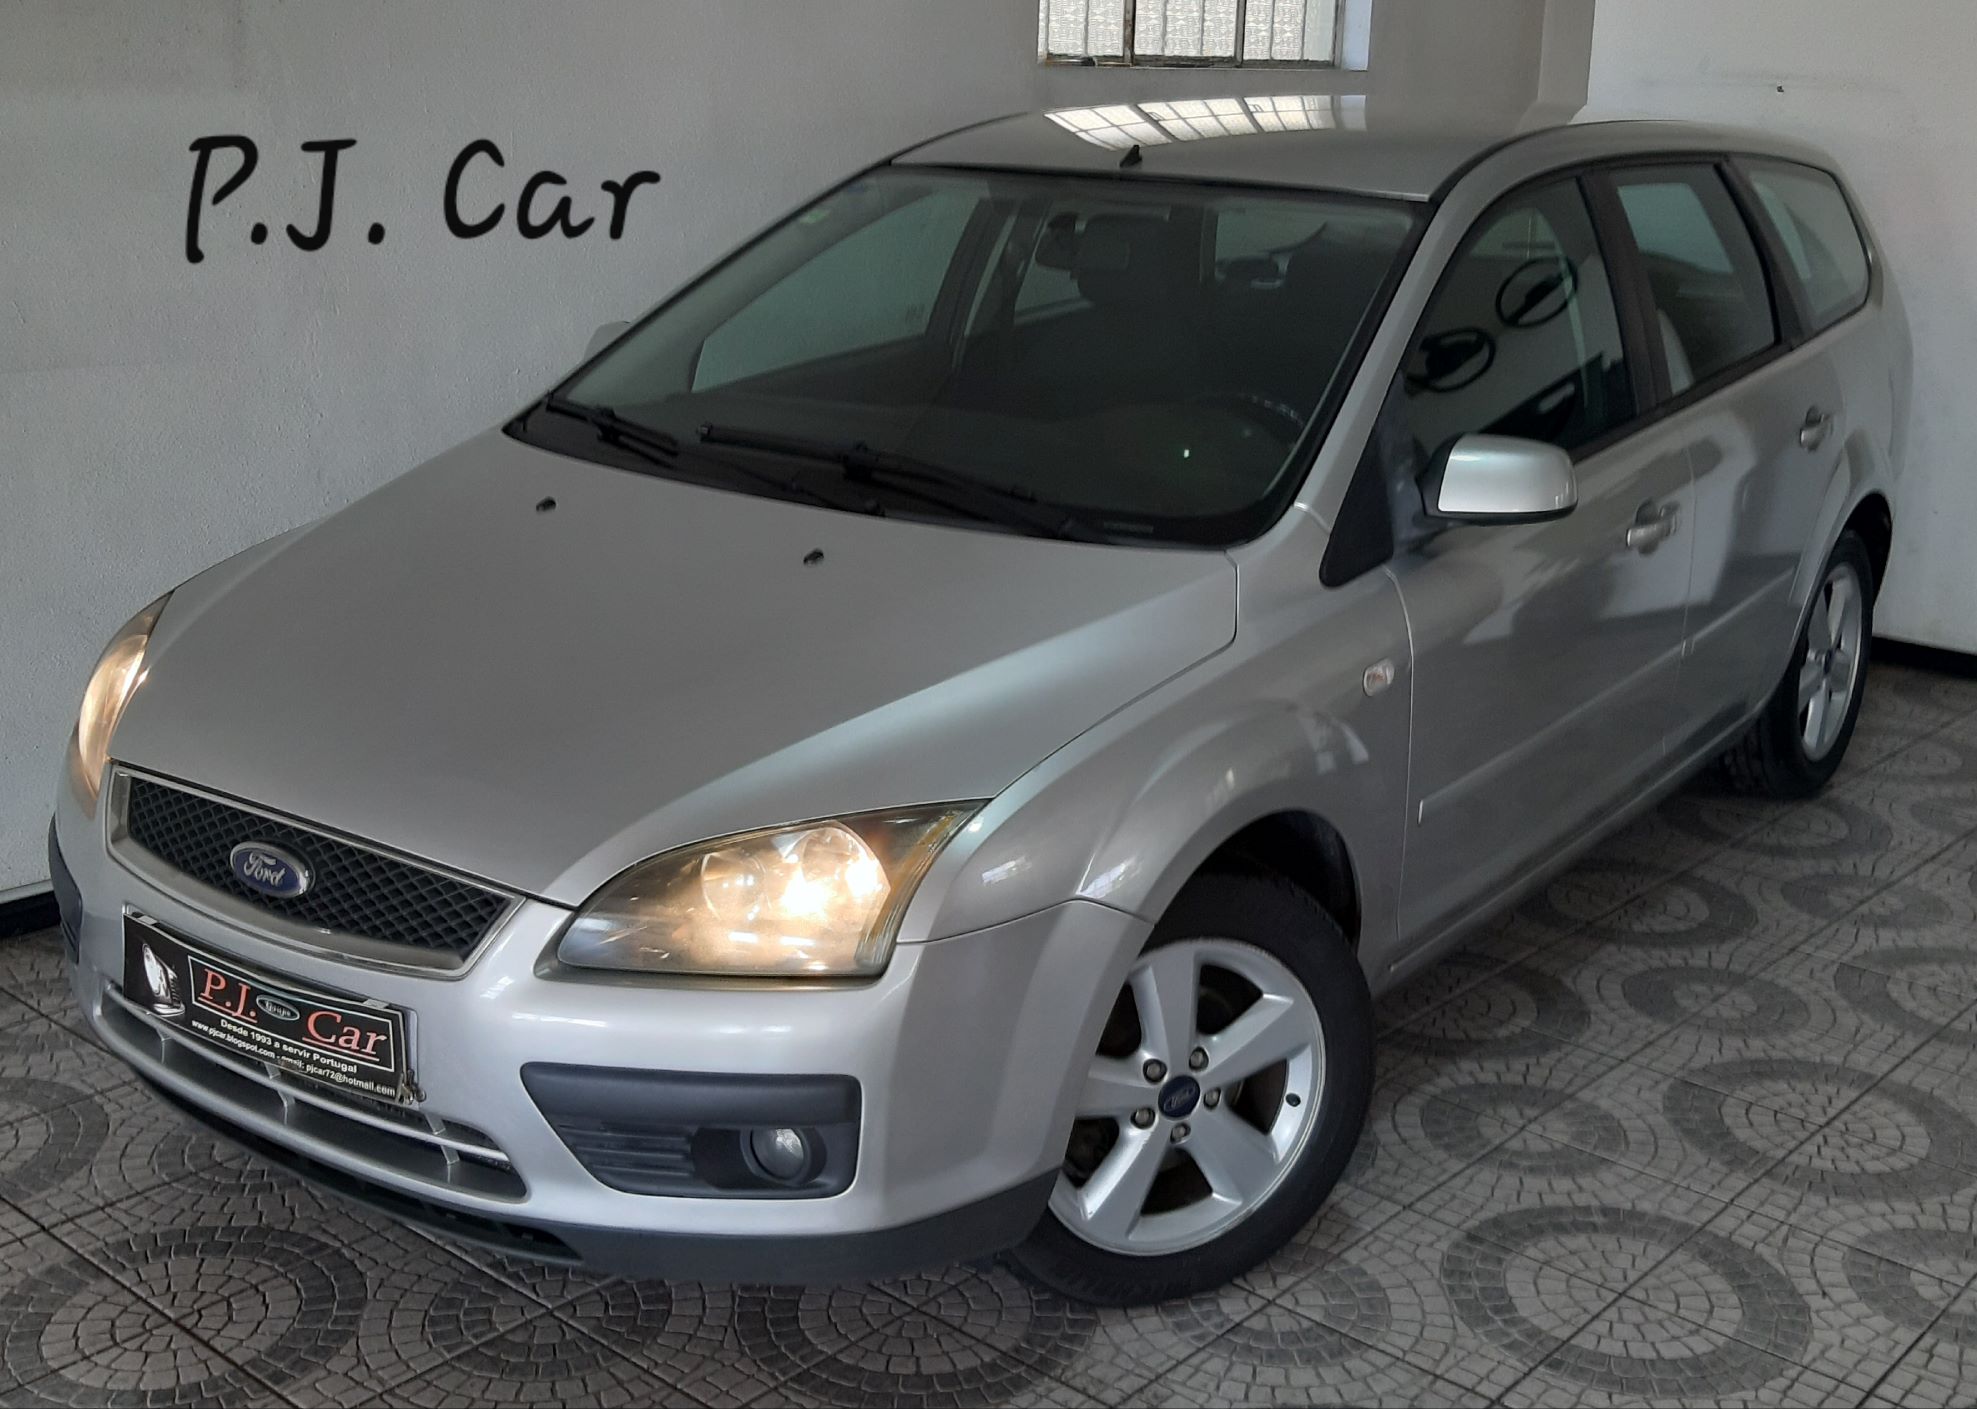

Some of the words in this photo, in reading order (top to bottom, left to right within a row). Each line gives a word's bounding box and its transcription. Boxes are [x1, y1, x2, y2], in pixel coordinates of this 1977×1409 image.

[186, 135, 385, 264] P.J.
[444, 138, 661, 241] Car
[244, 851, 286, 887] Ford
[200, 968, 258, 1018] P.J.
[307, 1011, 387, 1055] Car
[220, 1019, 249, 1037] Desde
[250, 1031, 272, 1046] 1993
[273, 1041, 280, 1049] a
[282, 1044, 311, 1058] servir
[313, 1053, 357, 1073] Portugal
[191, 1020, 276, 1059] www.pjcar.blogspot.com
[306, 1062, 396, 1098] pjcar72@hotmail.com
